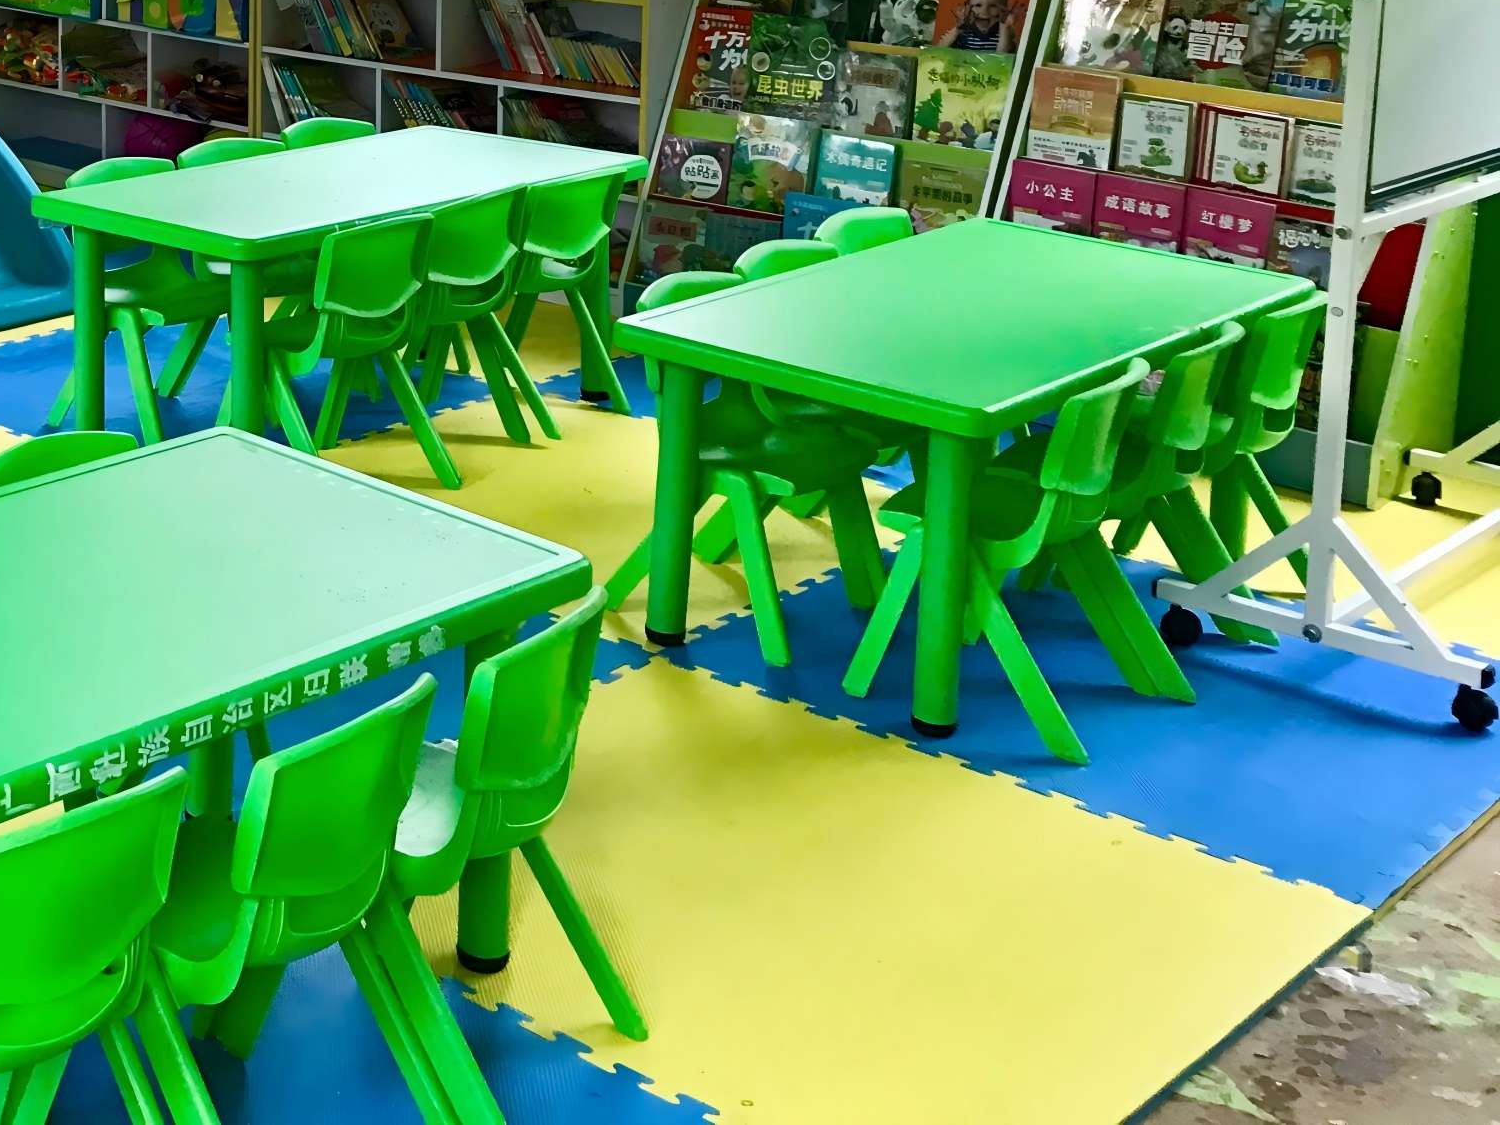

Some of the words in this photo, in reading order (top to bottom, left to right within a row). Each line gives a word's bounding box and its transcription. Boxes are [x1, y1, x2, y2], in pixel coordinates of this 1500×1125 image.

[704, 31, 751, 50] 十万
[756, 74, 824, 101] 昆虫世界
[1024, 179, 1075, 203] 小公主
[1103, 194, 1172, 220] 成语故事
